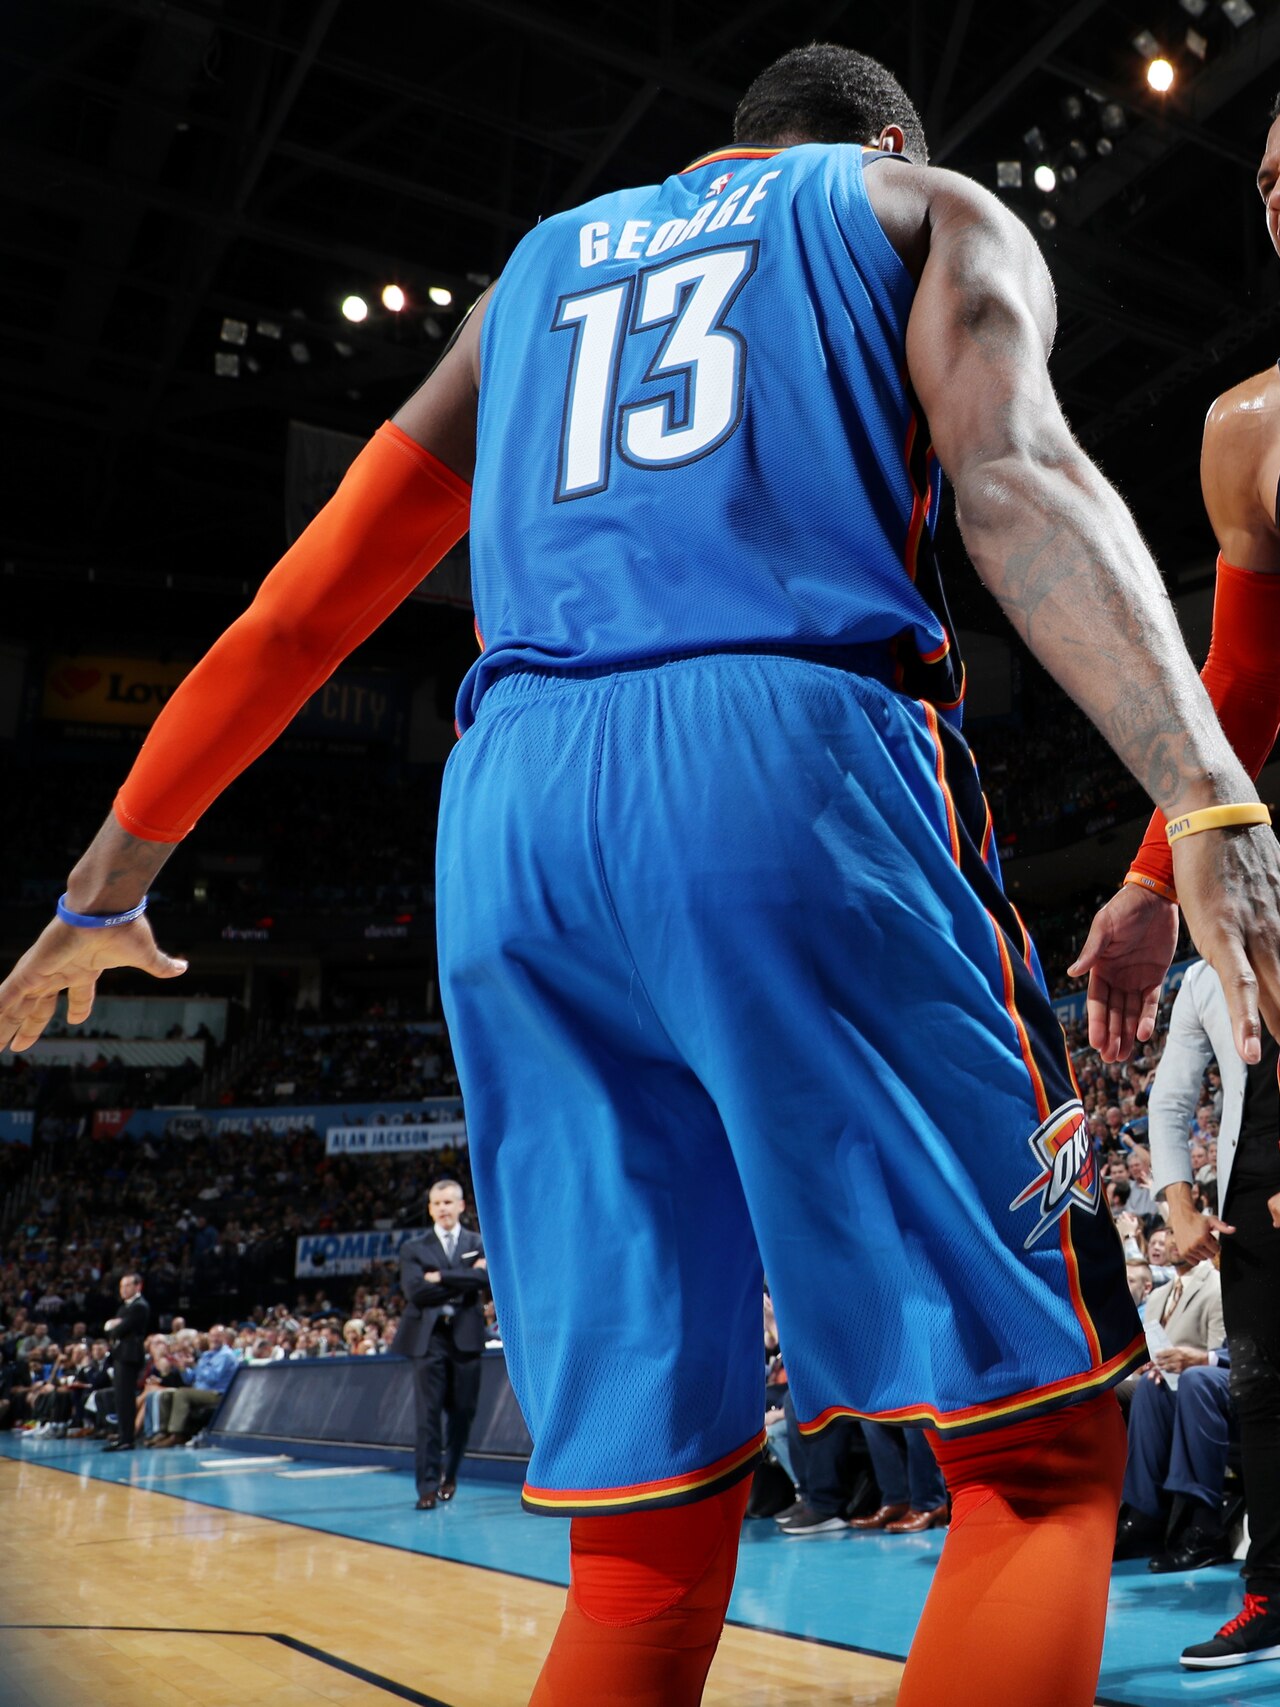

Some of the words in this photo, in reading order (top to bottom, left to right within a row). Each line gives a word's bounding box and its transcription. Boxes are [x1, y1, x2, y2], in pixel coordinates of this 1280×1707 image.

[579, 170, 782, 269] GEORGE
[550, 239, 760, 504] 13
[321, 680, 387, 735] CITY
[1168, 818, 1191, 837] LIVE
[98, 1110, 121, 1124] 112
[331, 1128, 366, 1149] ALAN
[370, 1130, 429, 1147] JACKSON
